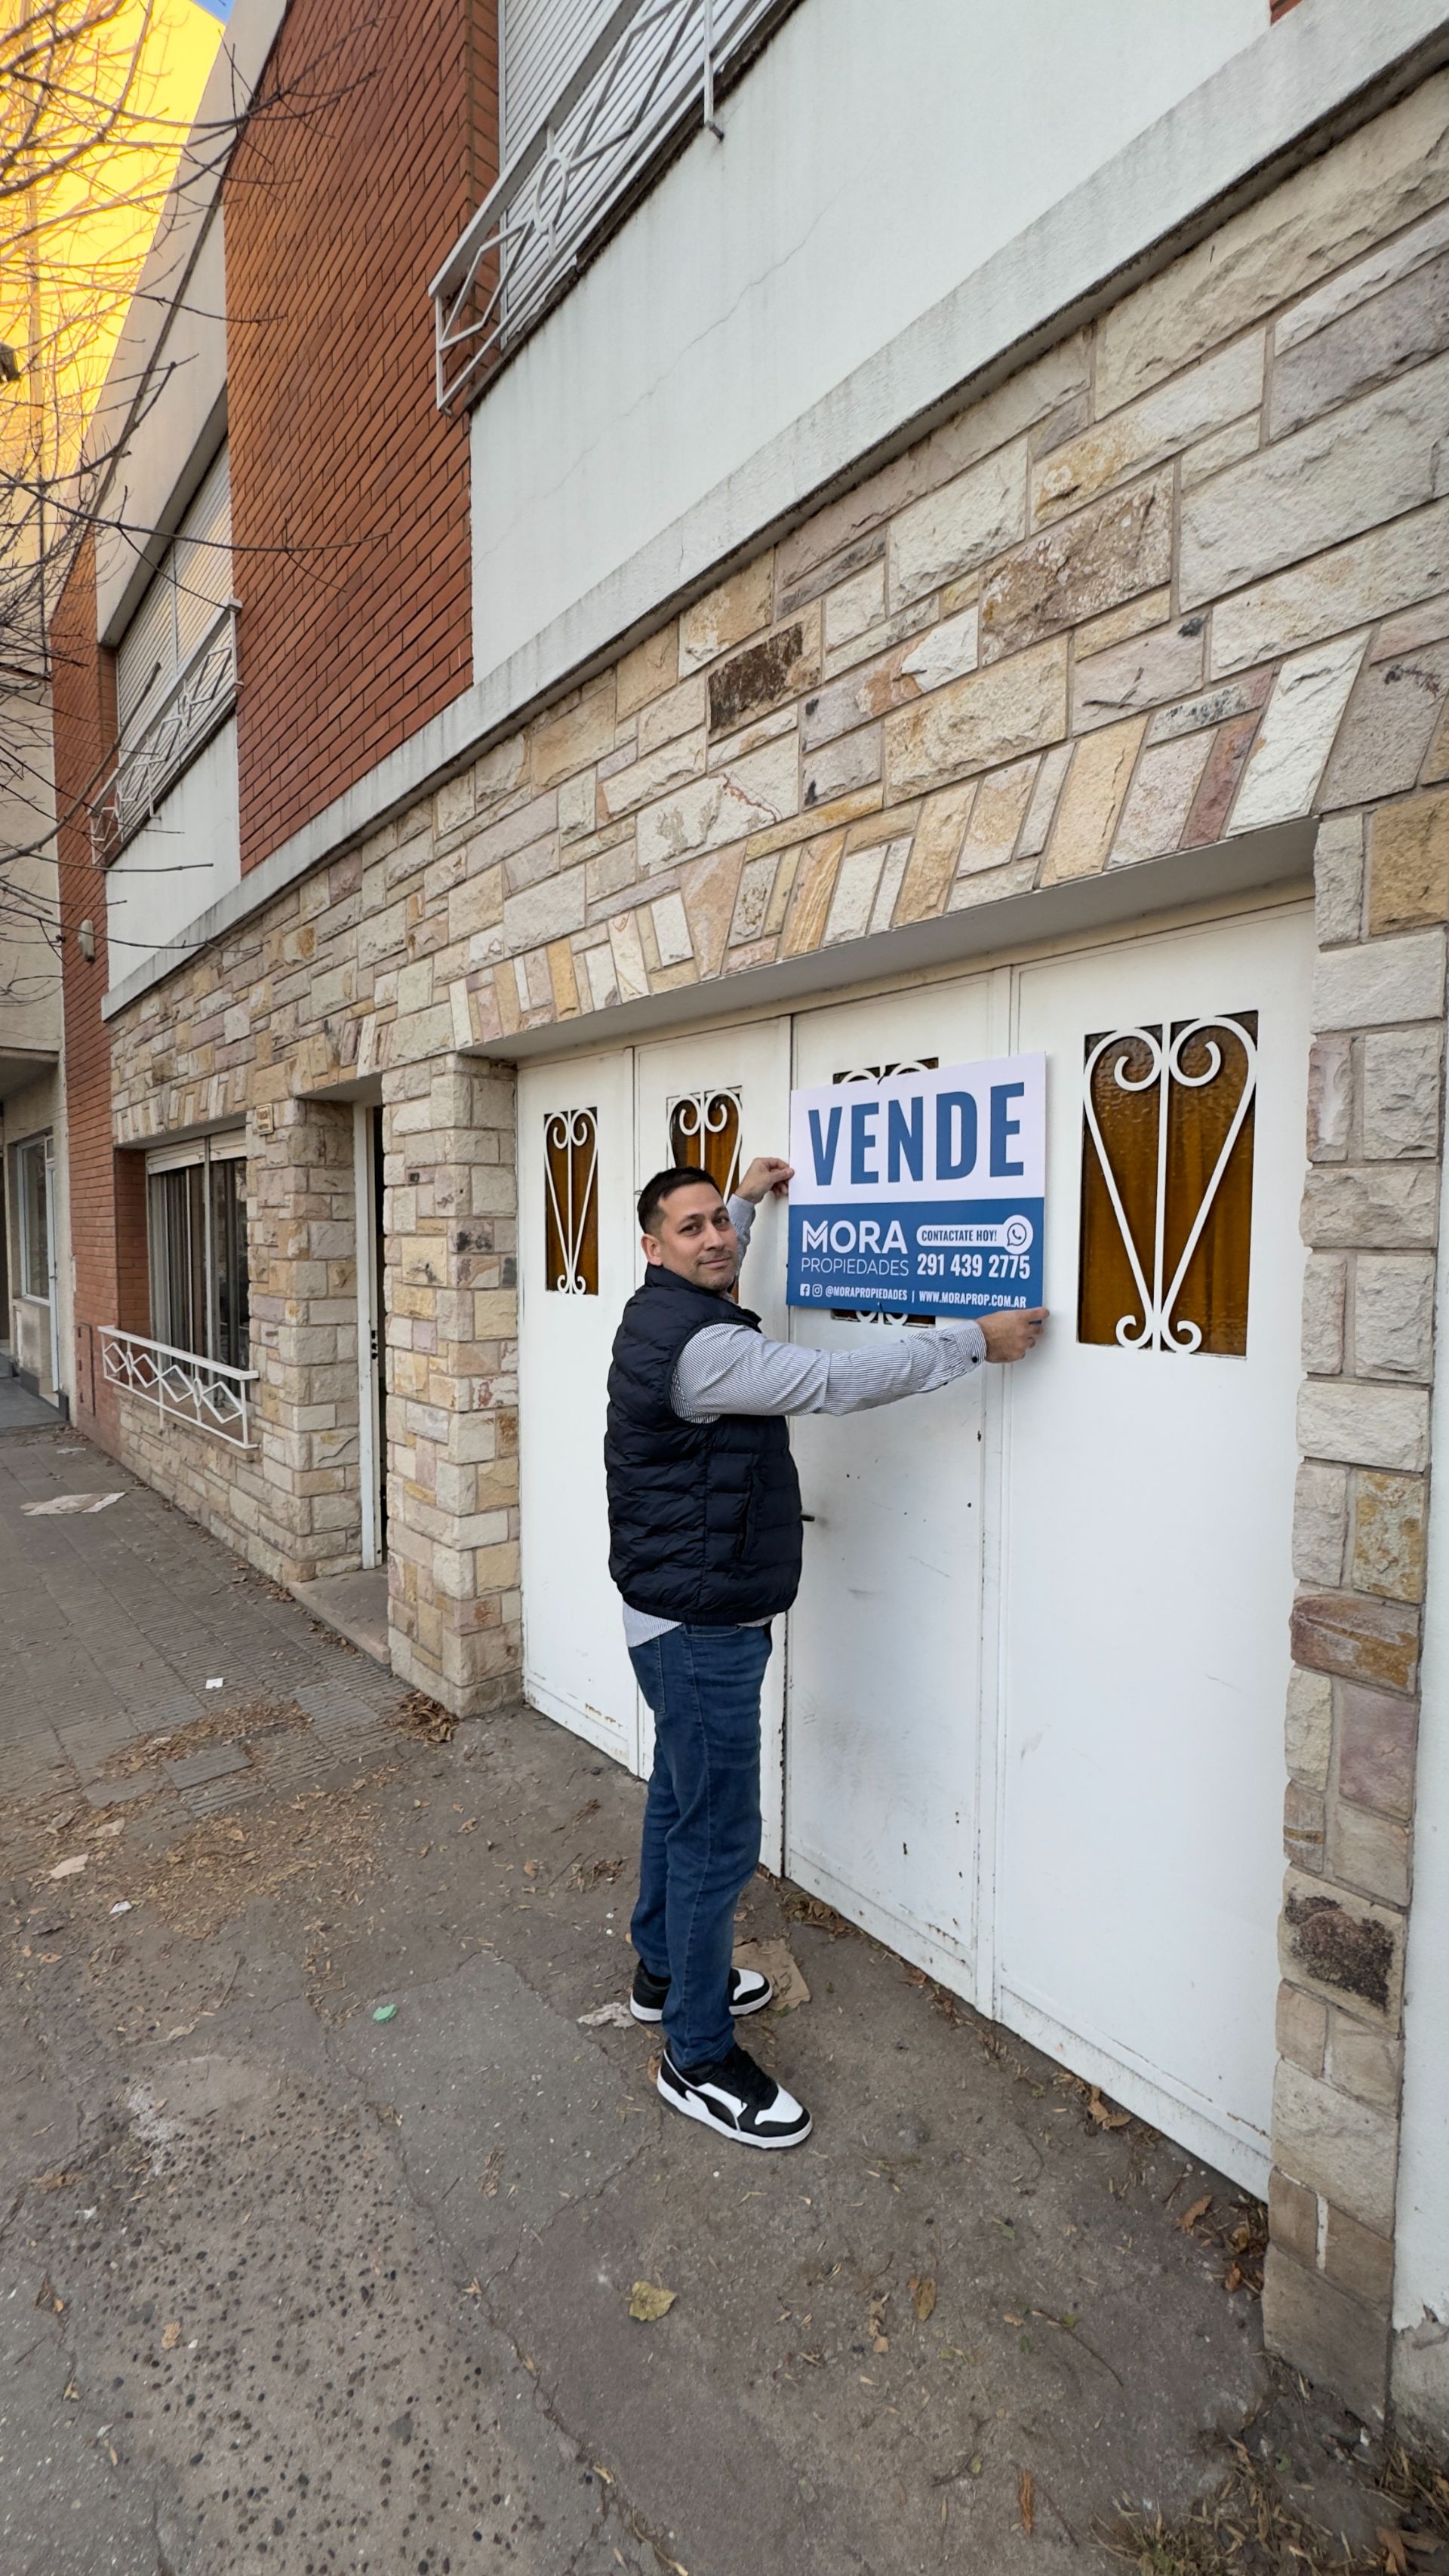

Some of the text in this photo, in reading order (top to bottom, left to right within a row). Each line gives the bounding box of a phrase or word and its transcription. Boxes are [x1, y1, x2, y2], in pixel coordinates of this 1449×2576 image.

[808, 1082, 1024, 1186] VENDE
[802, 1220, 908, 1254] MORA
[921, 1230, 997, 1242] CONTACTATE HOY!
[801, 1258, 909, 1276] PROPIEDADES
[917, 1254, 1030, 1279] 291 439 2775
[826, 1286, 1026, 1308] @MORAPROPIEDADES WWW.MORAPROP.COM.AR
